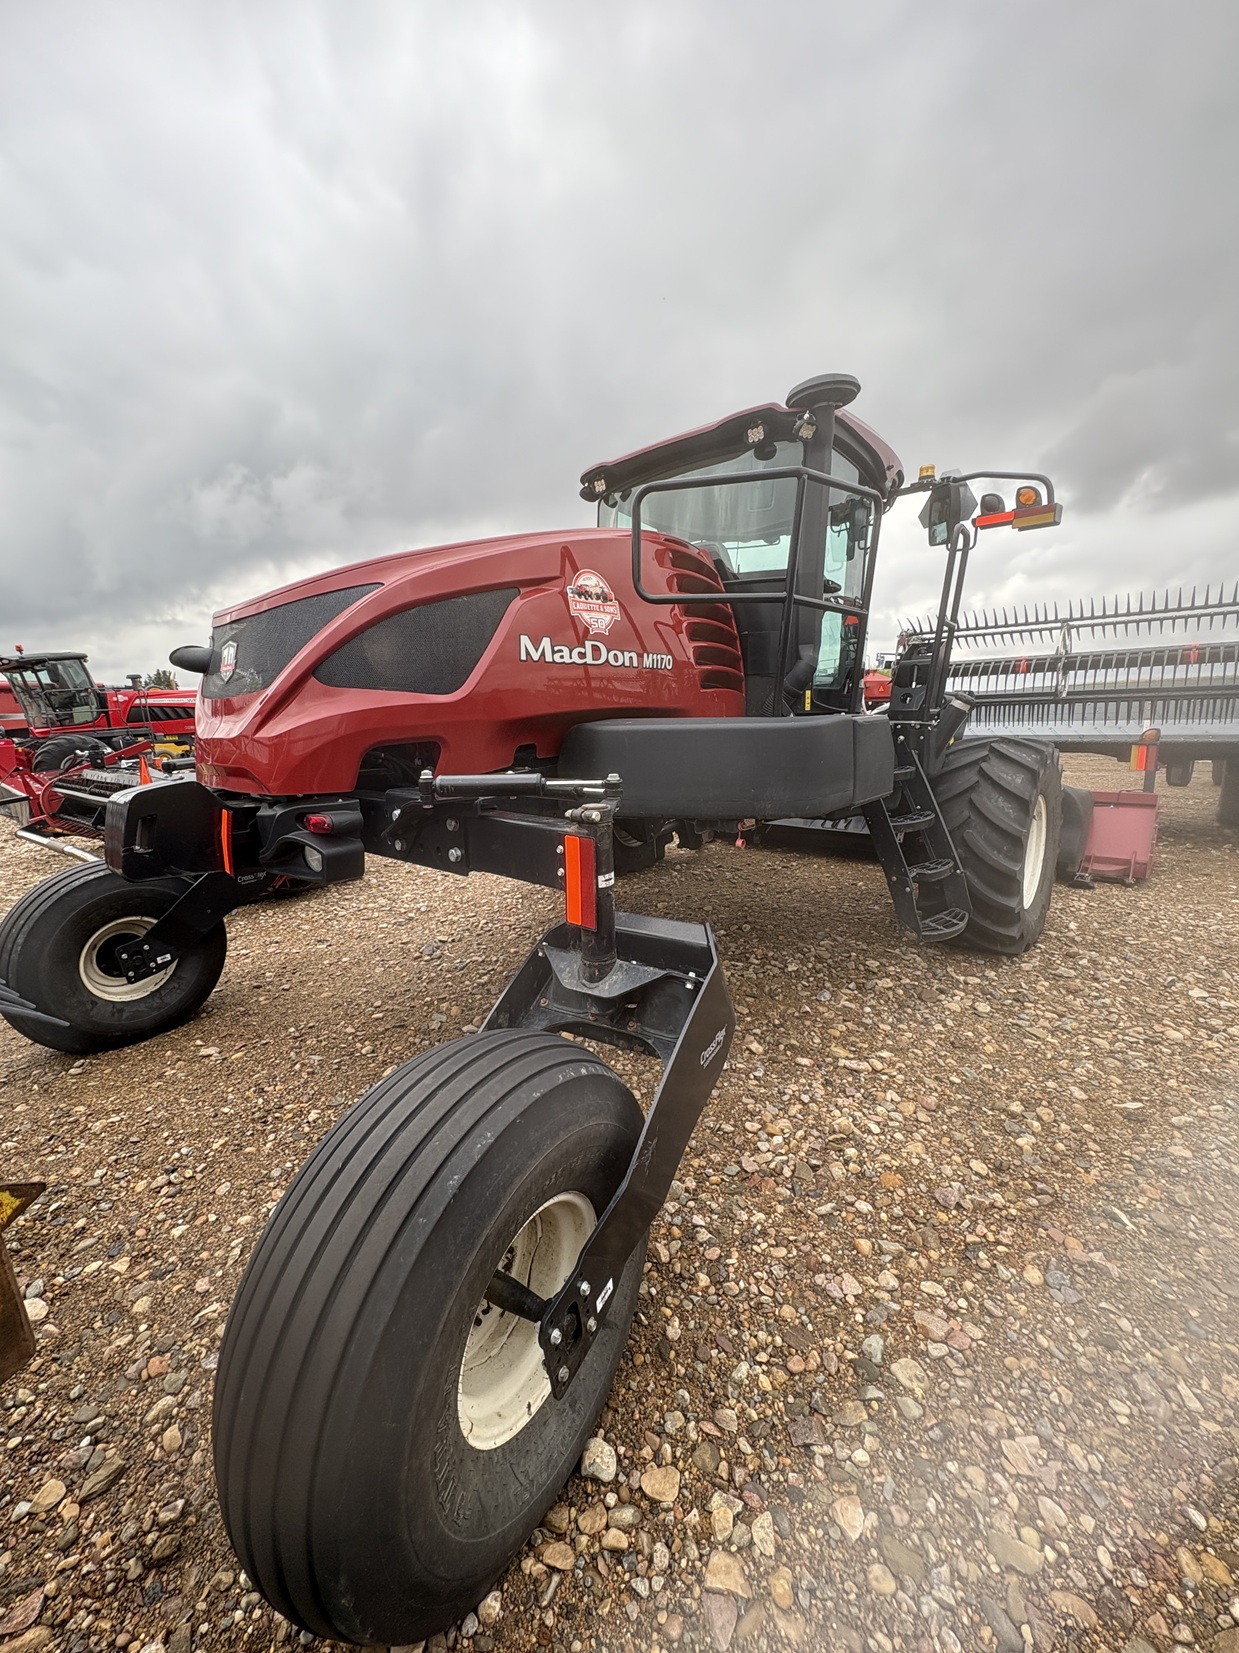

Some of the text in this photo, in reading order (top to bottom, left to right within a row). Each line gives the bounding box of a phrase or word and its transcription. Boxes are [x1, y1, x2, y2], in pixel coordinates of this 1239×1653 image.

[604, 605, 617, 614] SONS
[590, 617, 606, 629] 50
[519, 634, 673, 669] MacDon M1170
